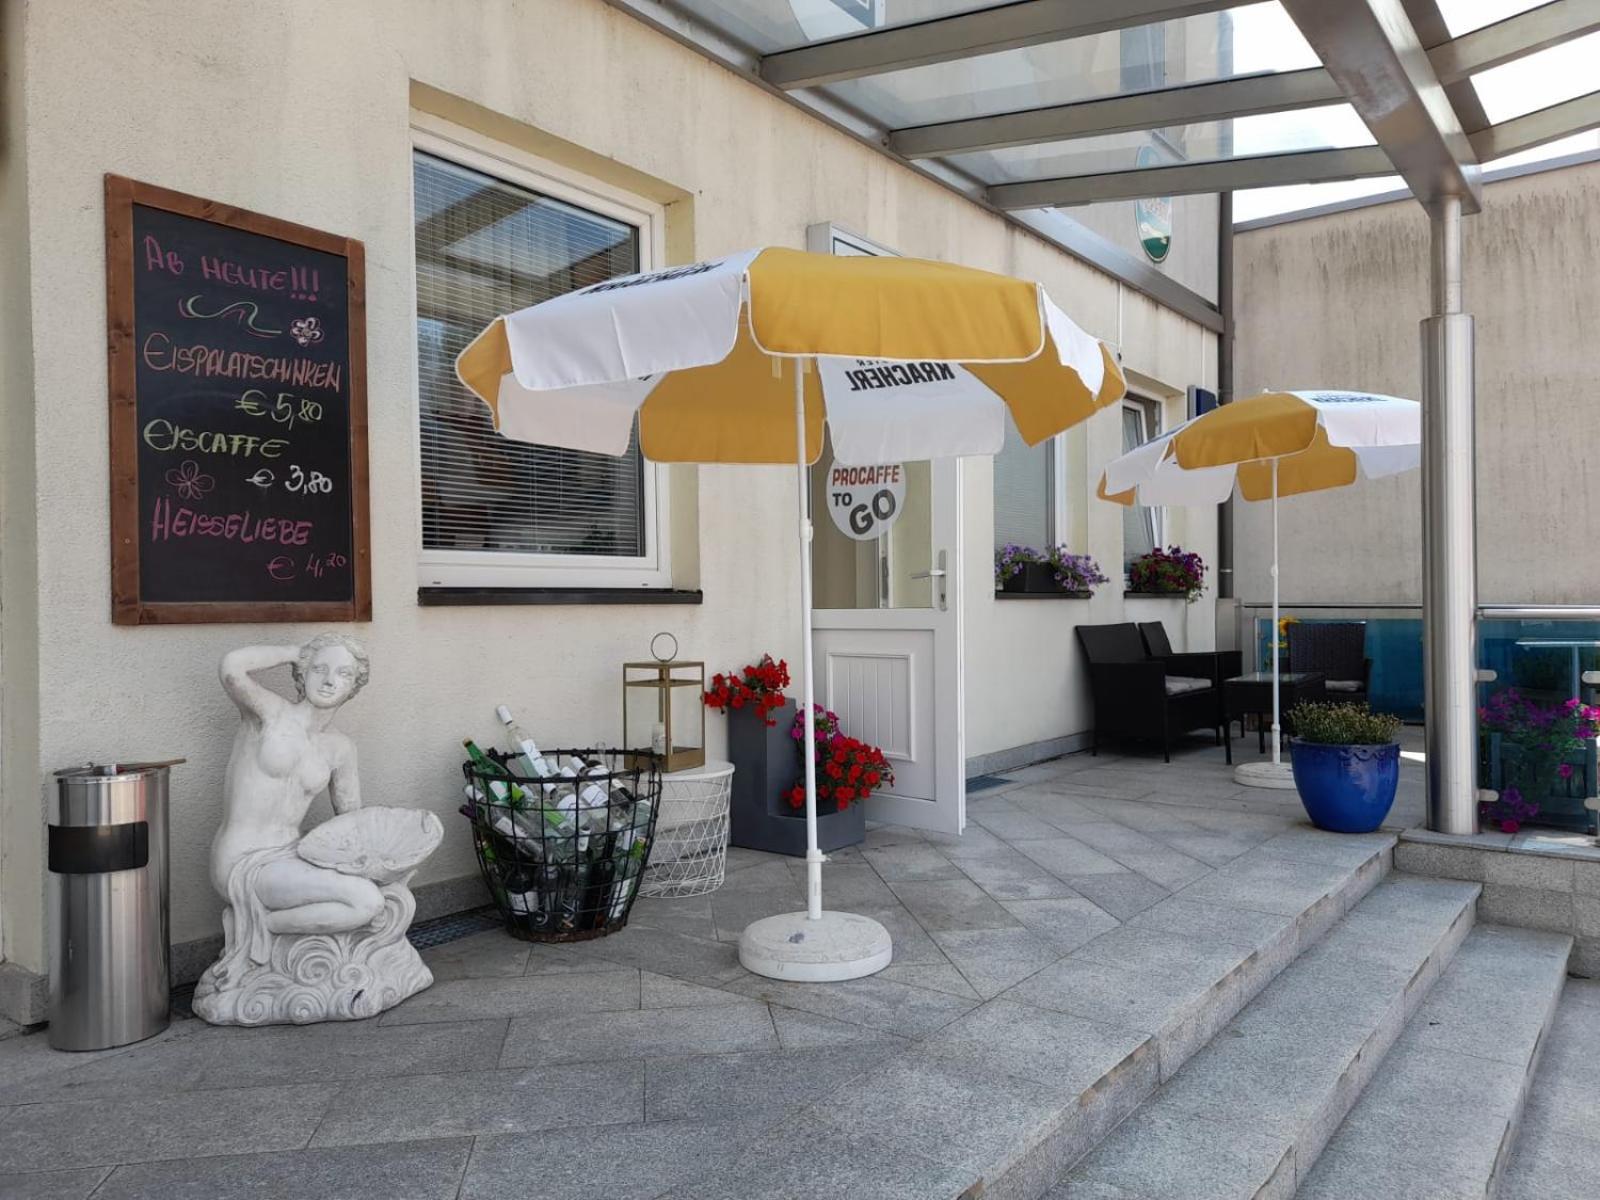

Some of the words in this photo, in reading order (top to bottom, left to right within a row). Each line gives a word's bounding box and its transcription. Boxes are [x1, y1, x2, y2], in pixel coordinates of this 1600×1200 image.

[201, 255, 320, 302] HEUTE!!!
[143, 418, 290, 458] EISCAFFE
[284, 464, 333, 494] 3,80
[832, 465, 900, 486] PROCAFFE
[832, 492, 853, 507] TO
[849, 489, 897, 535] GO
